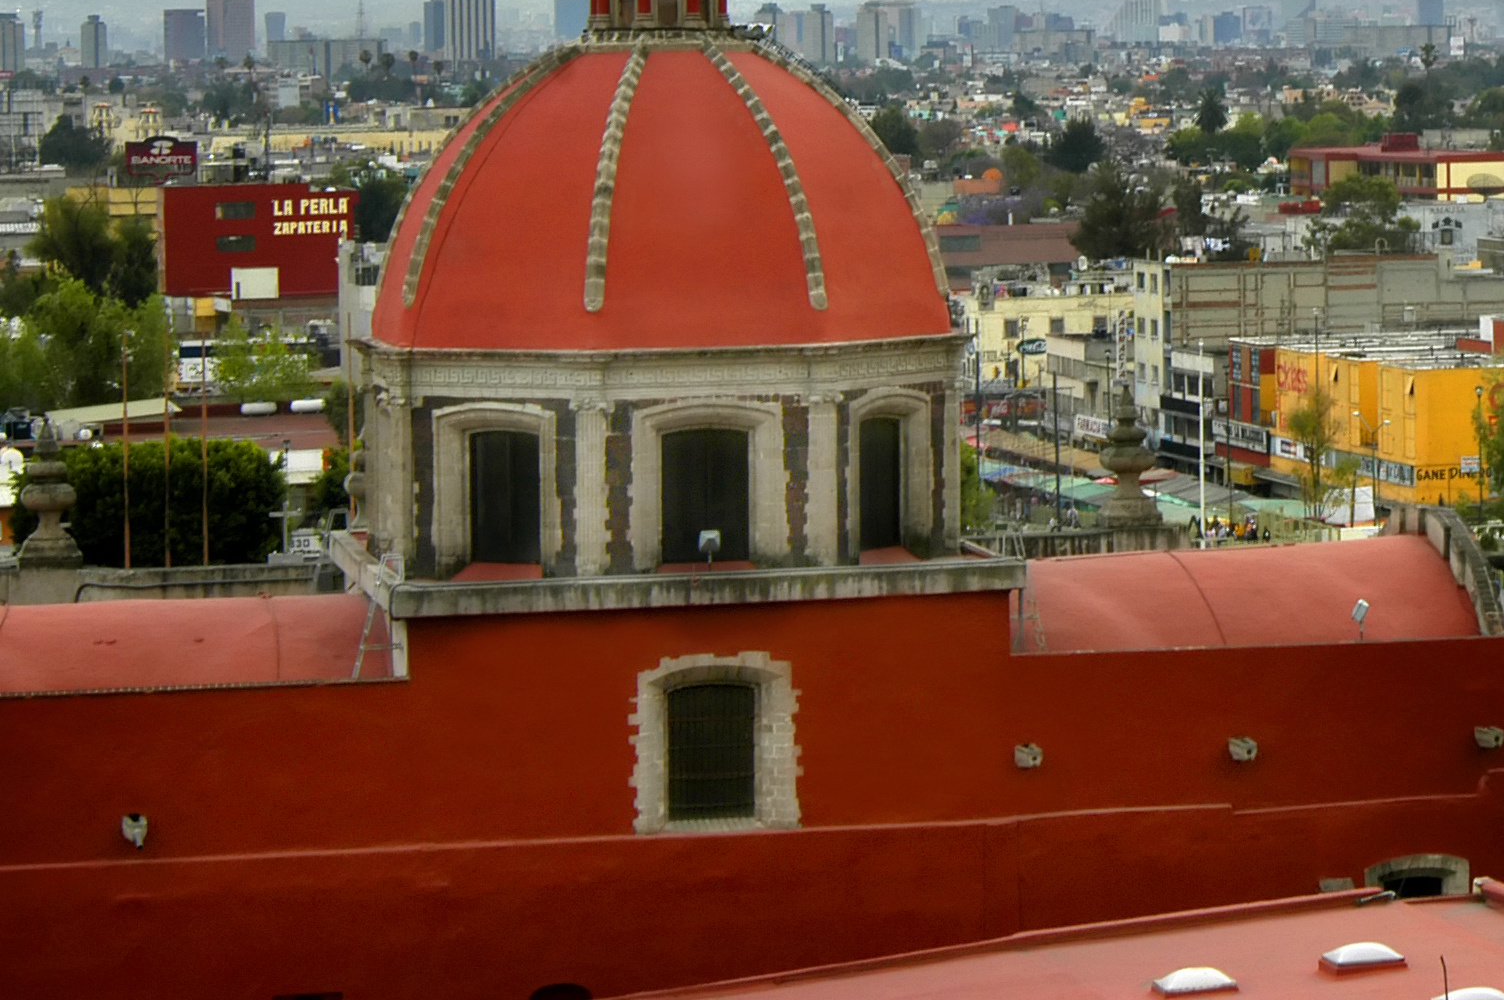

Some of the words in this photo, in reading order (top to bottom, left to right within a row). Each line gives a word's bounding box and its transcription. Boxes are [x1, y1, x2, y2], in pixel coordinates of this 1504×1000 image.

[131, 155, 192, 165] BANORTE
[273, 219, 348, 236] ZAPATERIA
[1118, 310, 1127, 379] FARMACIA
[1416, 468, 1446, 481] GANE
